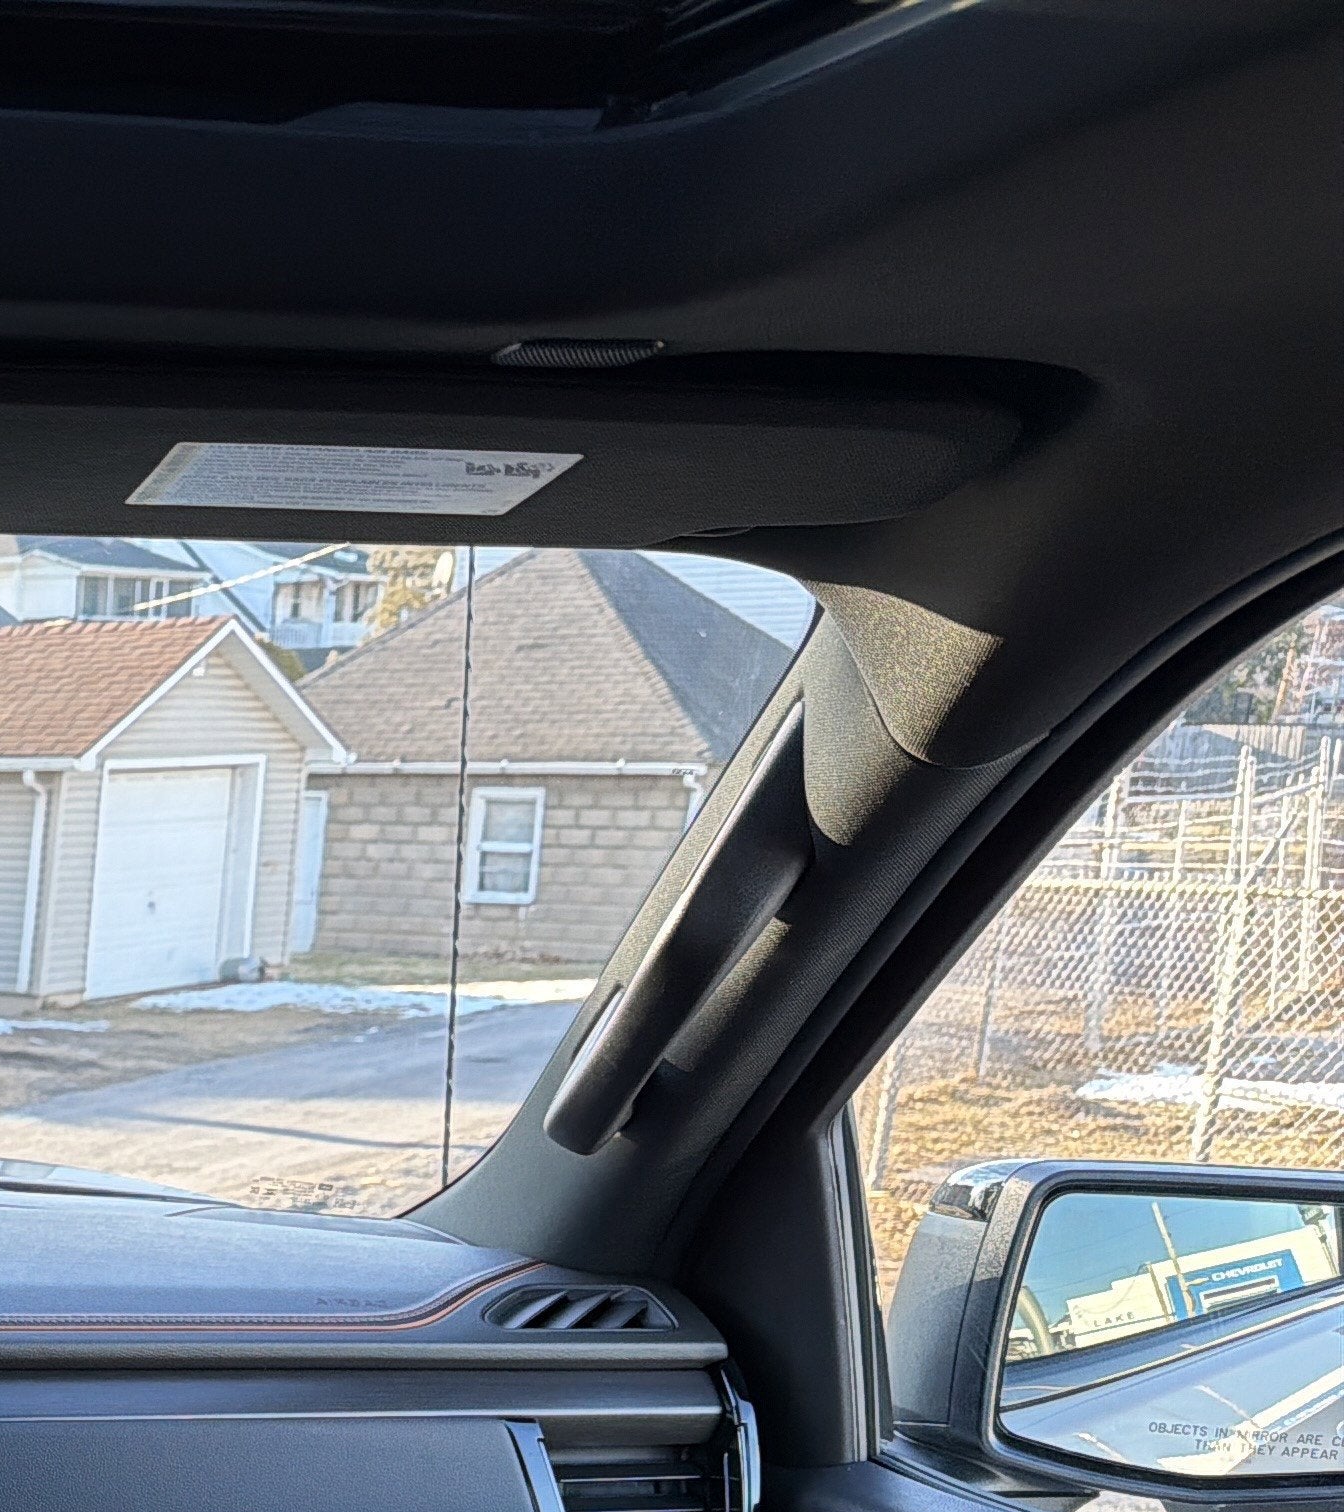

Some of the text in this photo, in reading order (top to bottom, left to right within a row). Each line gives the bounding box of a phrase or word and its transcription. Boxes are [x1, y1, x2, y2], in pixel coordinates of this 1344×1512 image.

[1148, 1421, 1208, 1437] OBJECTS
[1215, 1427, 1229, 1438] IN
[1296, 1433, 1323, 1447] ARE
[1281, 1445, 1339, 1461] APPEAR
